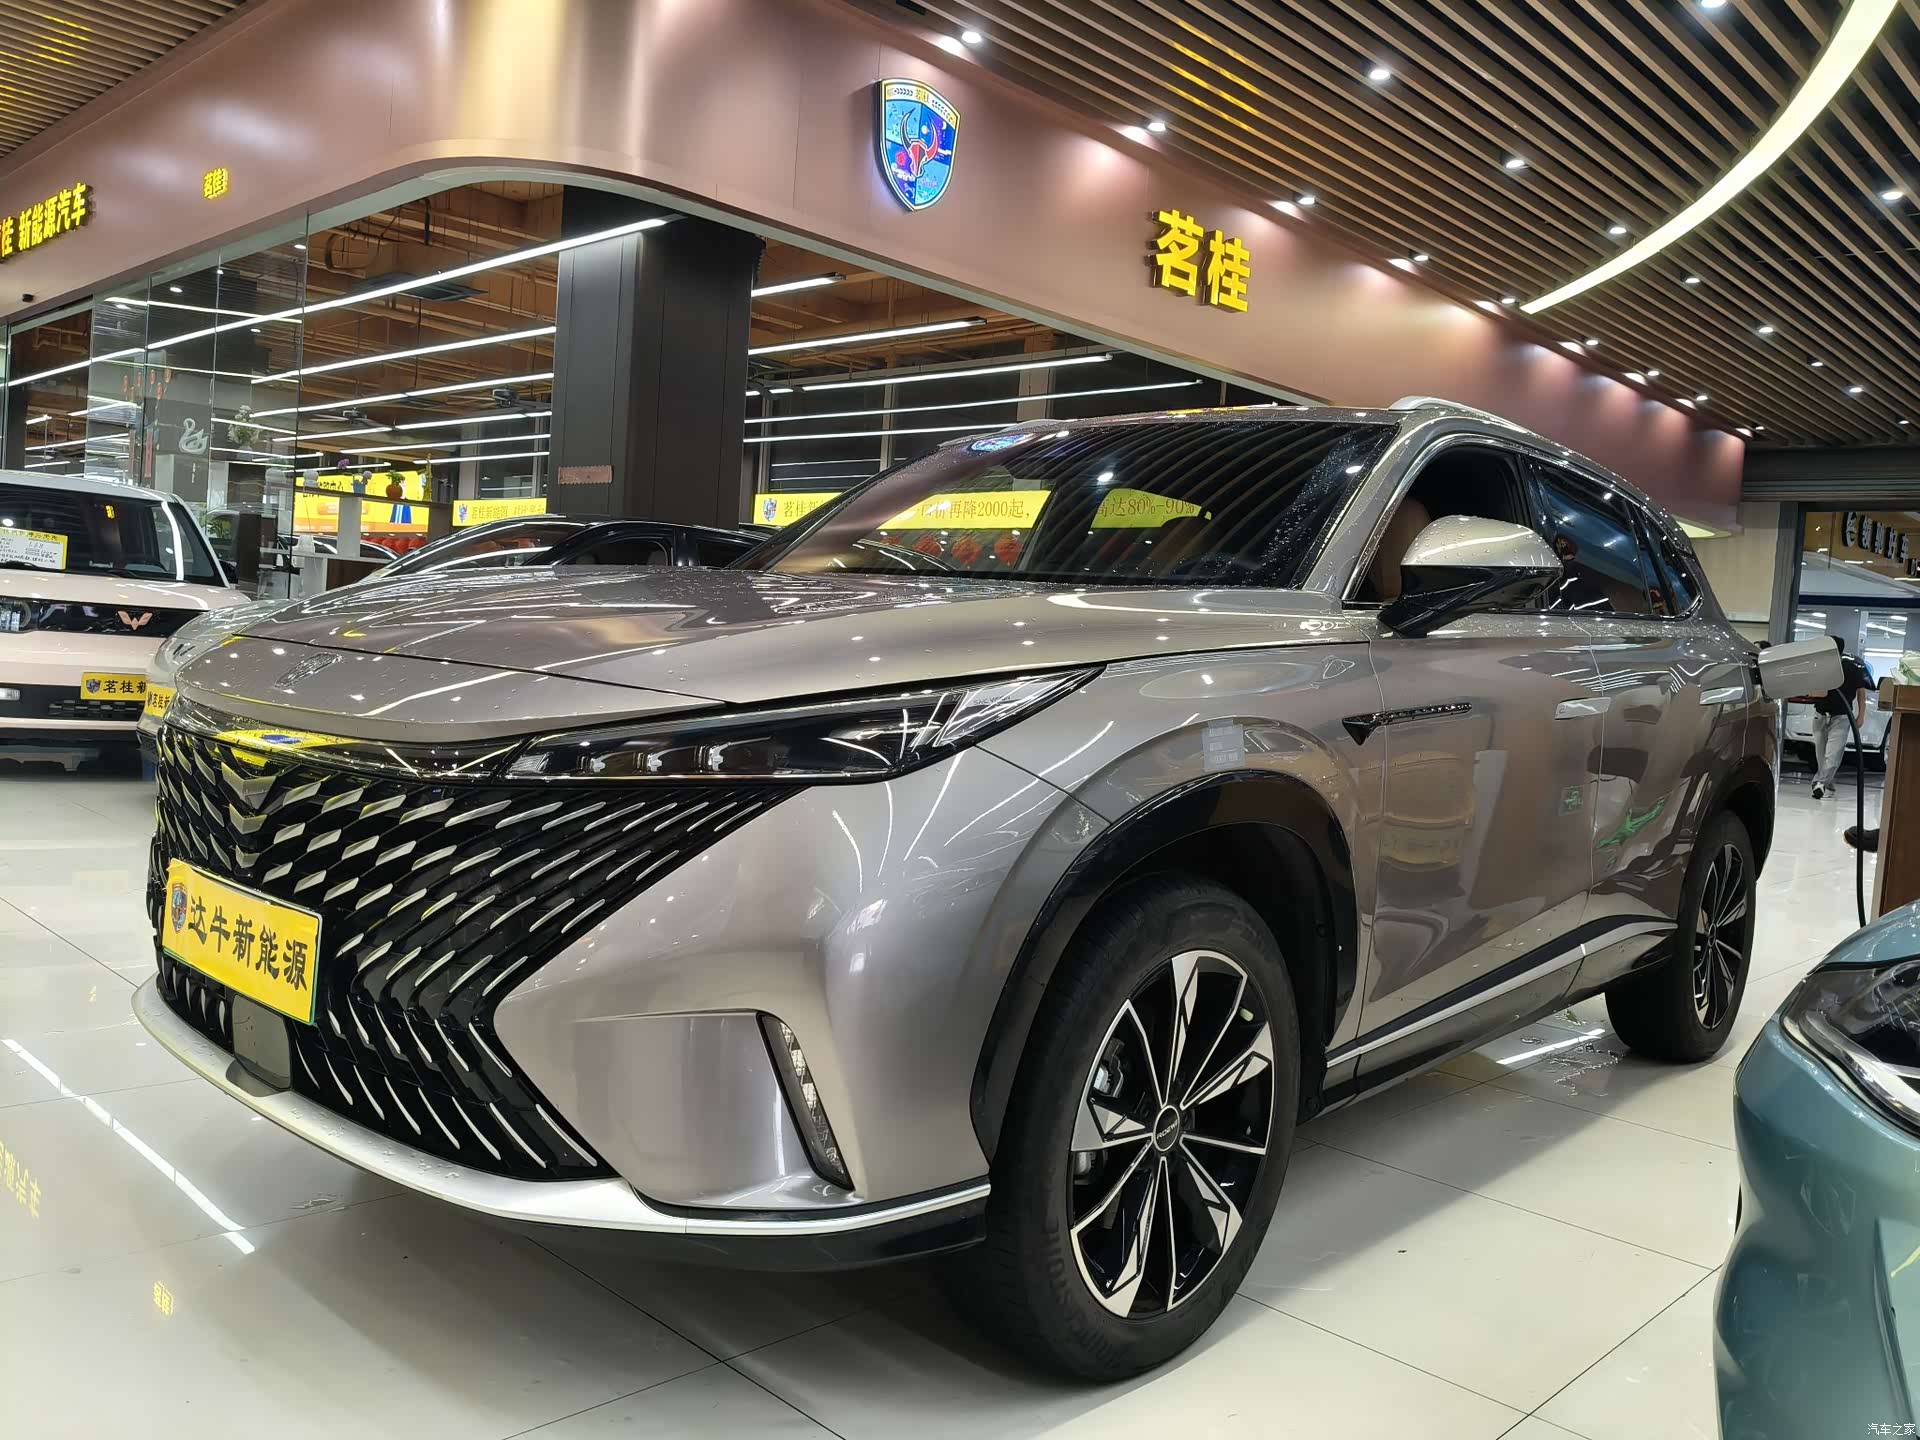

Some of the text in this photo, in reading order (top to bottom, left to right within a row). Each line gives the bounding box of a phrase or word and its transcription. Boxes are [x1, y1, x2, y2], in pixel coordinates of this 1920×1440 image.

[0, 183, 86, 257] 桂 新能源汽车
[1156, 209, 1251, 312] 茗桂
[188, 895, 308, 991] 达牛新能源
